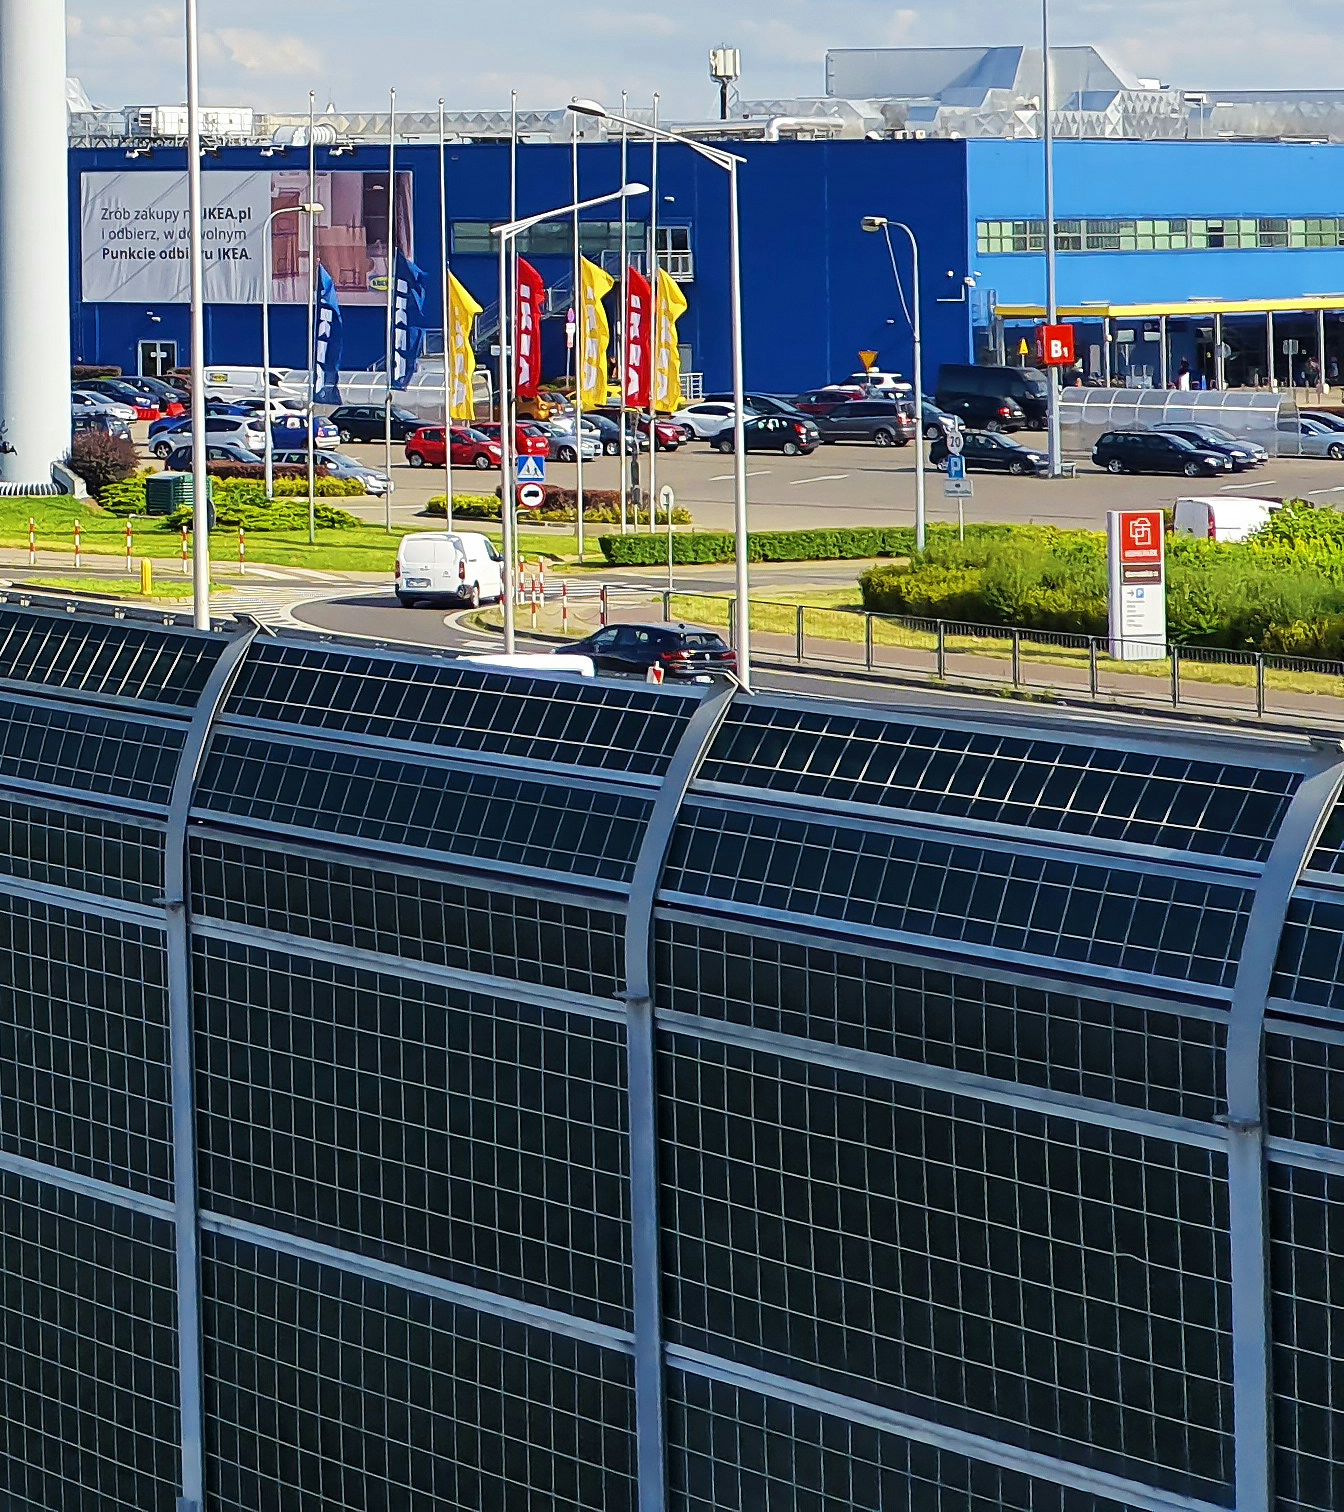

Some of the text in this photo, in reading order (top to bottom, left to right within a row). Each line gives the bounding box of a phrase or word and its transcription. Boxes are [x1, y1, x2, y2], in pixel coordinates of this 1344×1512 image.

[100, 207, 130, 220] Zrób
[134, 207, 180, 223] zakupy
[203, 207, 252, 223] IKEA.pl
[164, 230, 175, 240] w
[178, 227, 247, 243] dolnym
[102, 247, 156, 261] Punkcie
[159, 247, 213, 261] odbiu
[1050, 339, 1069, 358] B1
